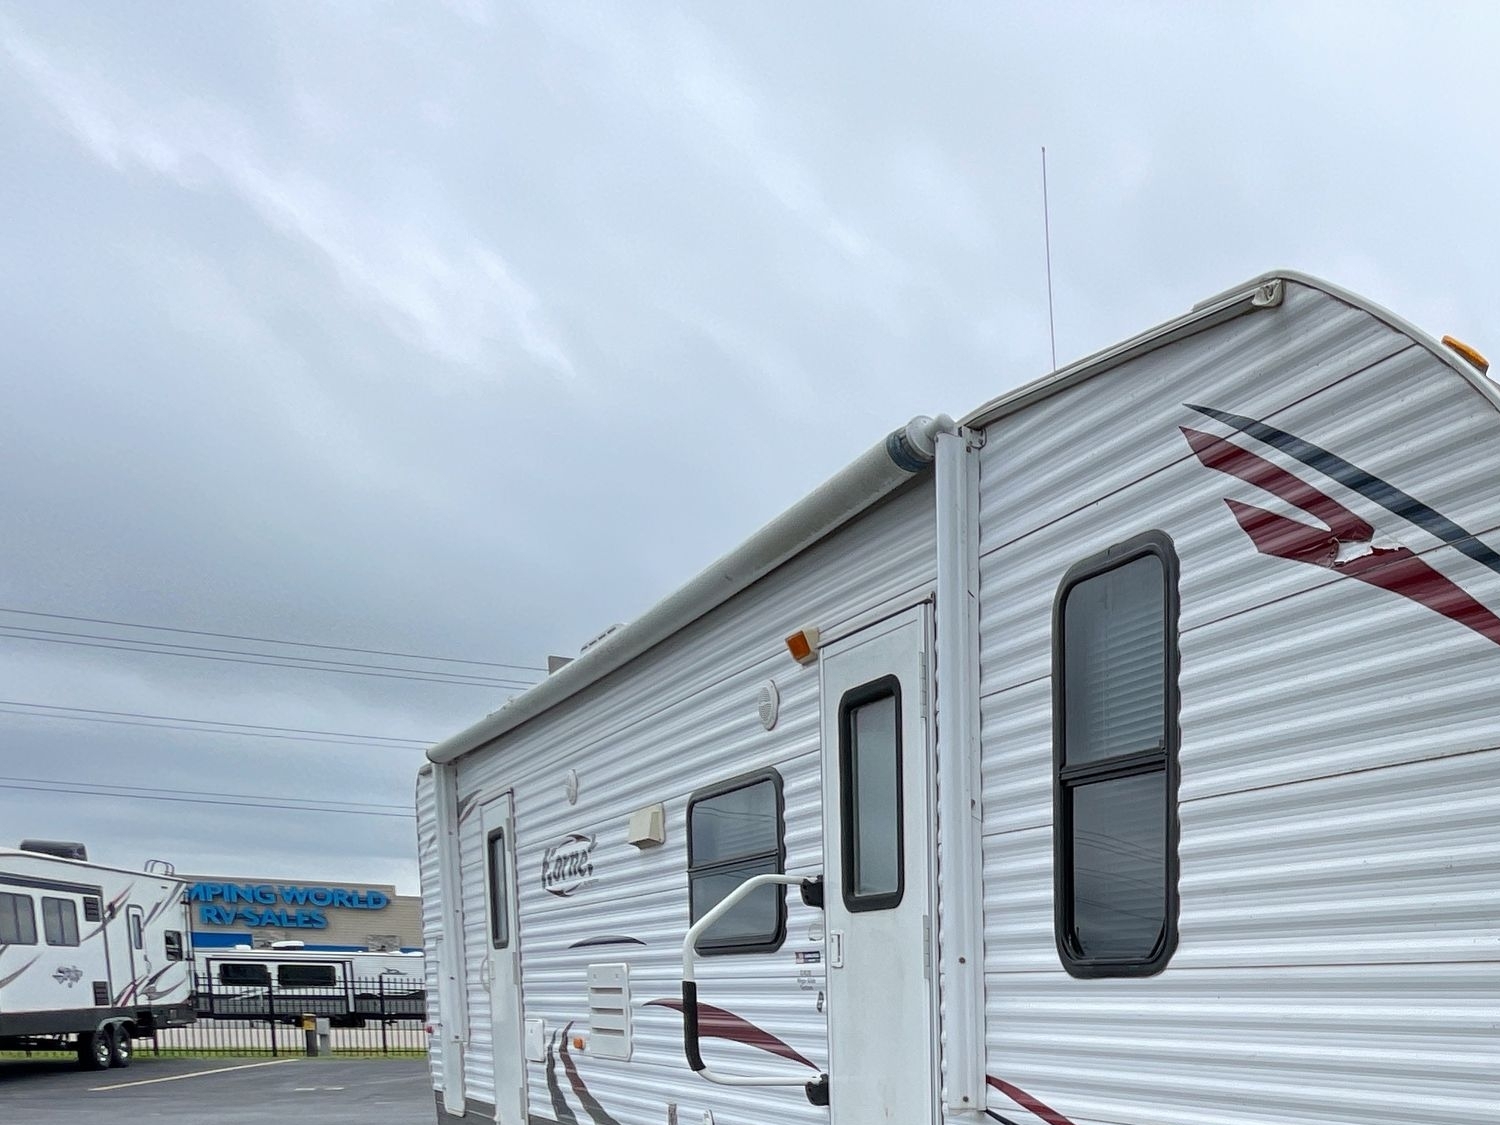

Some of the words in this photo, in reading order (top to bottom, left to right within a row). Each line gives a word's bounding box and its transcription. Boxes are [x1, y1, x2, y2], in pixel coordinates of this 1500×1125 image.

[277, 885, 390, 910] WORLD
[201, 905, 236, 925] RV
[245, 907, 328, 929] SALES
